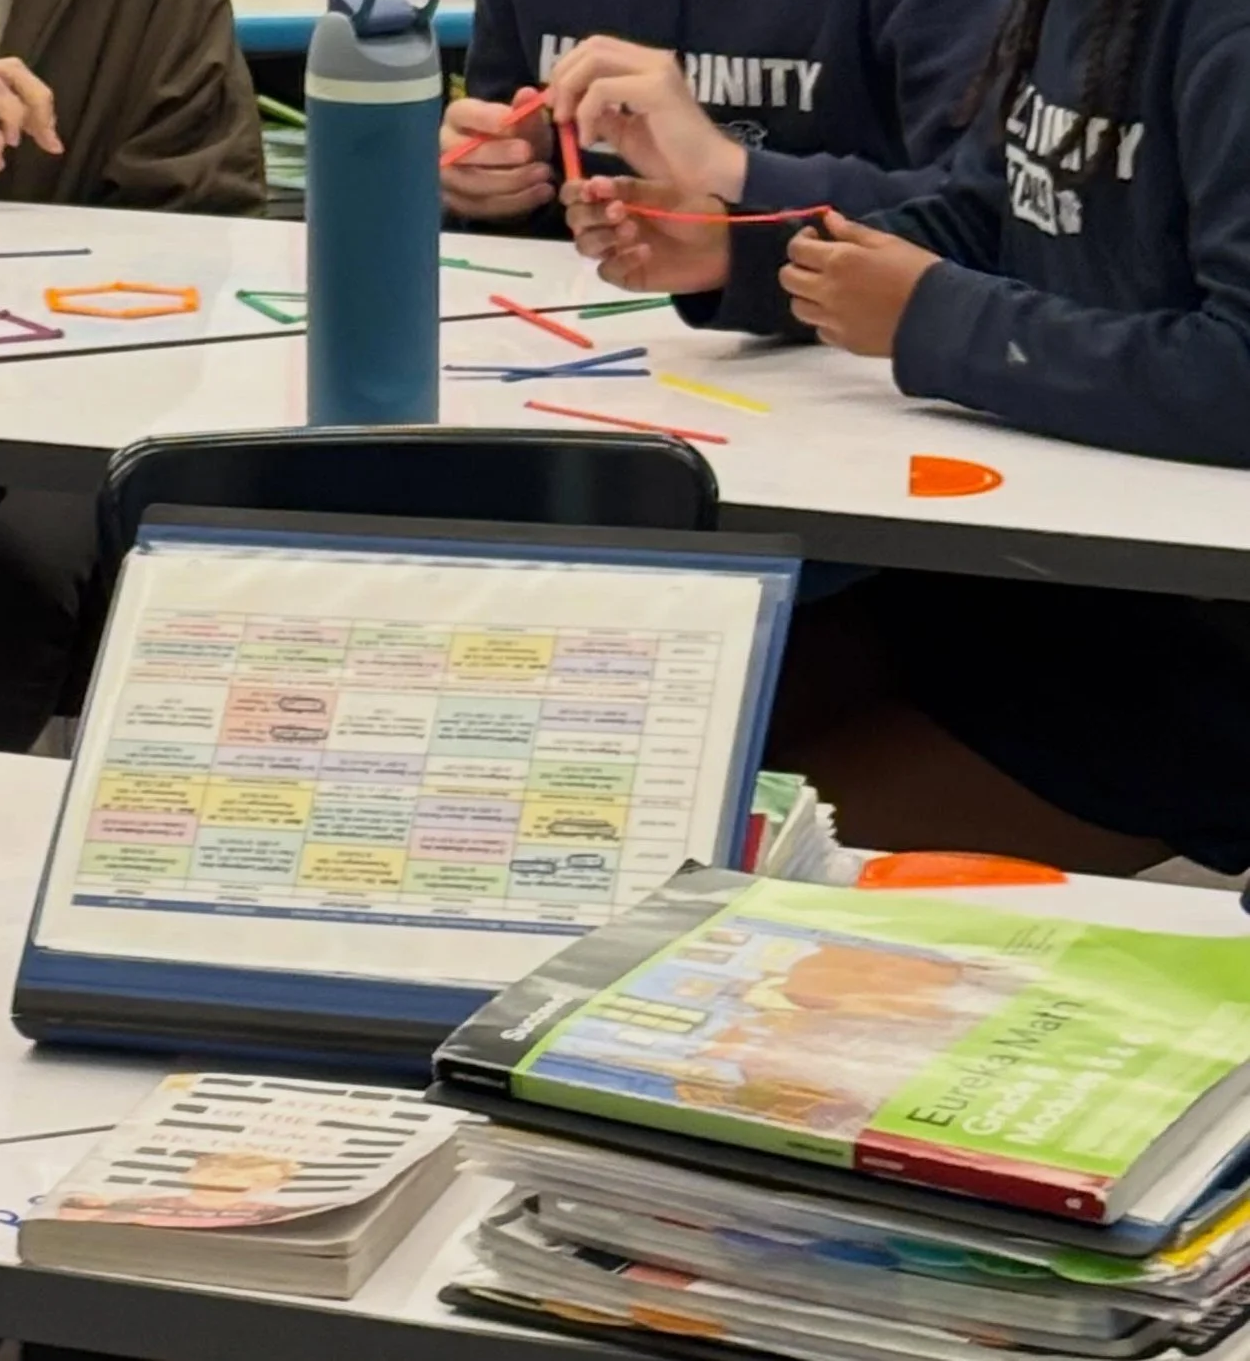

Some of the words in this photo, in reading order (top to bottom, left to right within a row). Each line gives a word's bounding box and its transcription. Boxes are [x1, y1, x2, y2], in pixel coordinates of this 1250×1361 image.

[906, 1052, 1022, 1127] Eureka
[992, 1000, 1085, 1051] Math
[962, 1080, 1041, 1135] Grade
